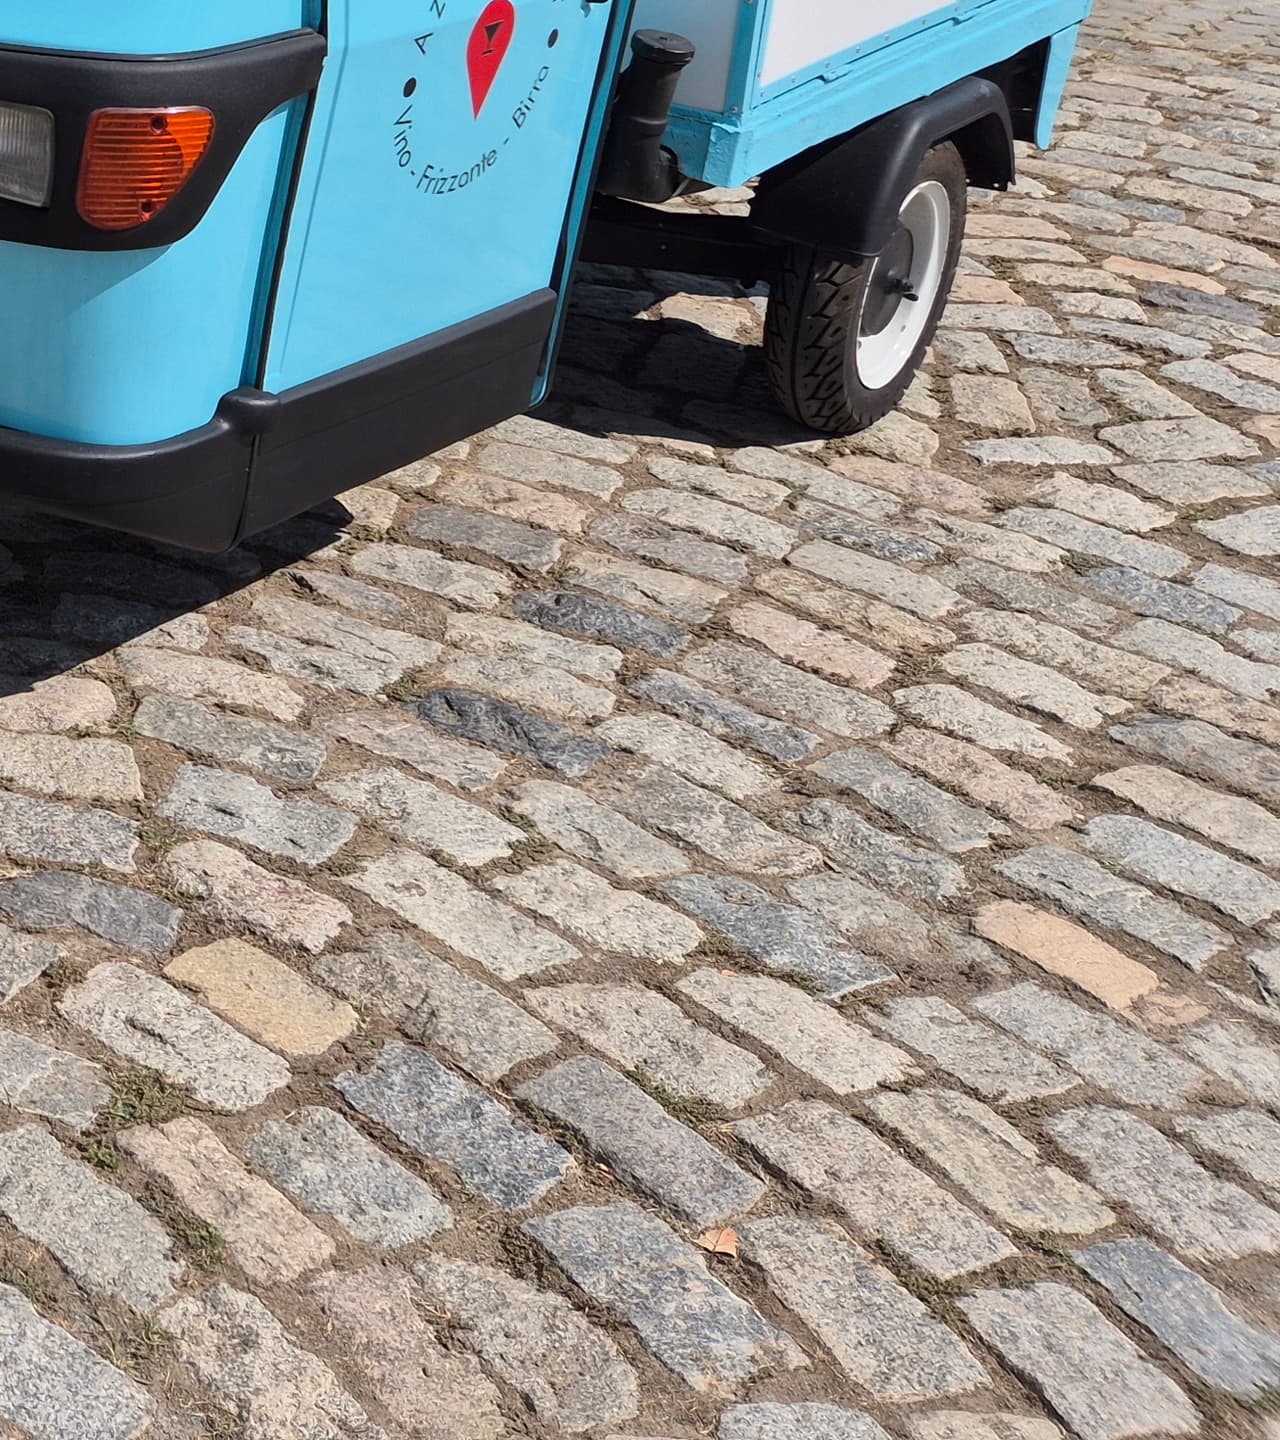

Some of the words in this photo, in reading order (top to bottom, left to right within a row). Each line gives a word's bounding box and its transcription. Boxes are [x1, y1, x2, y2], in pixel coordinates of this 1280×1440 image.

[393, 103, 414, 168] Vino
[415, 148, 498, 195] Frizzante
[511, 65, 550, 129] Birra
